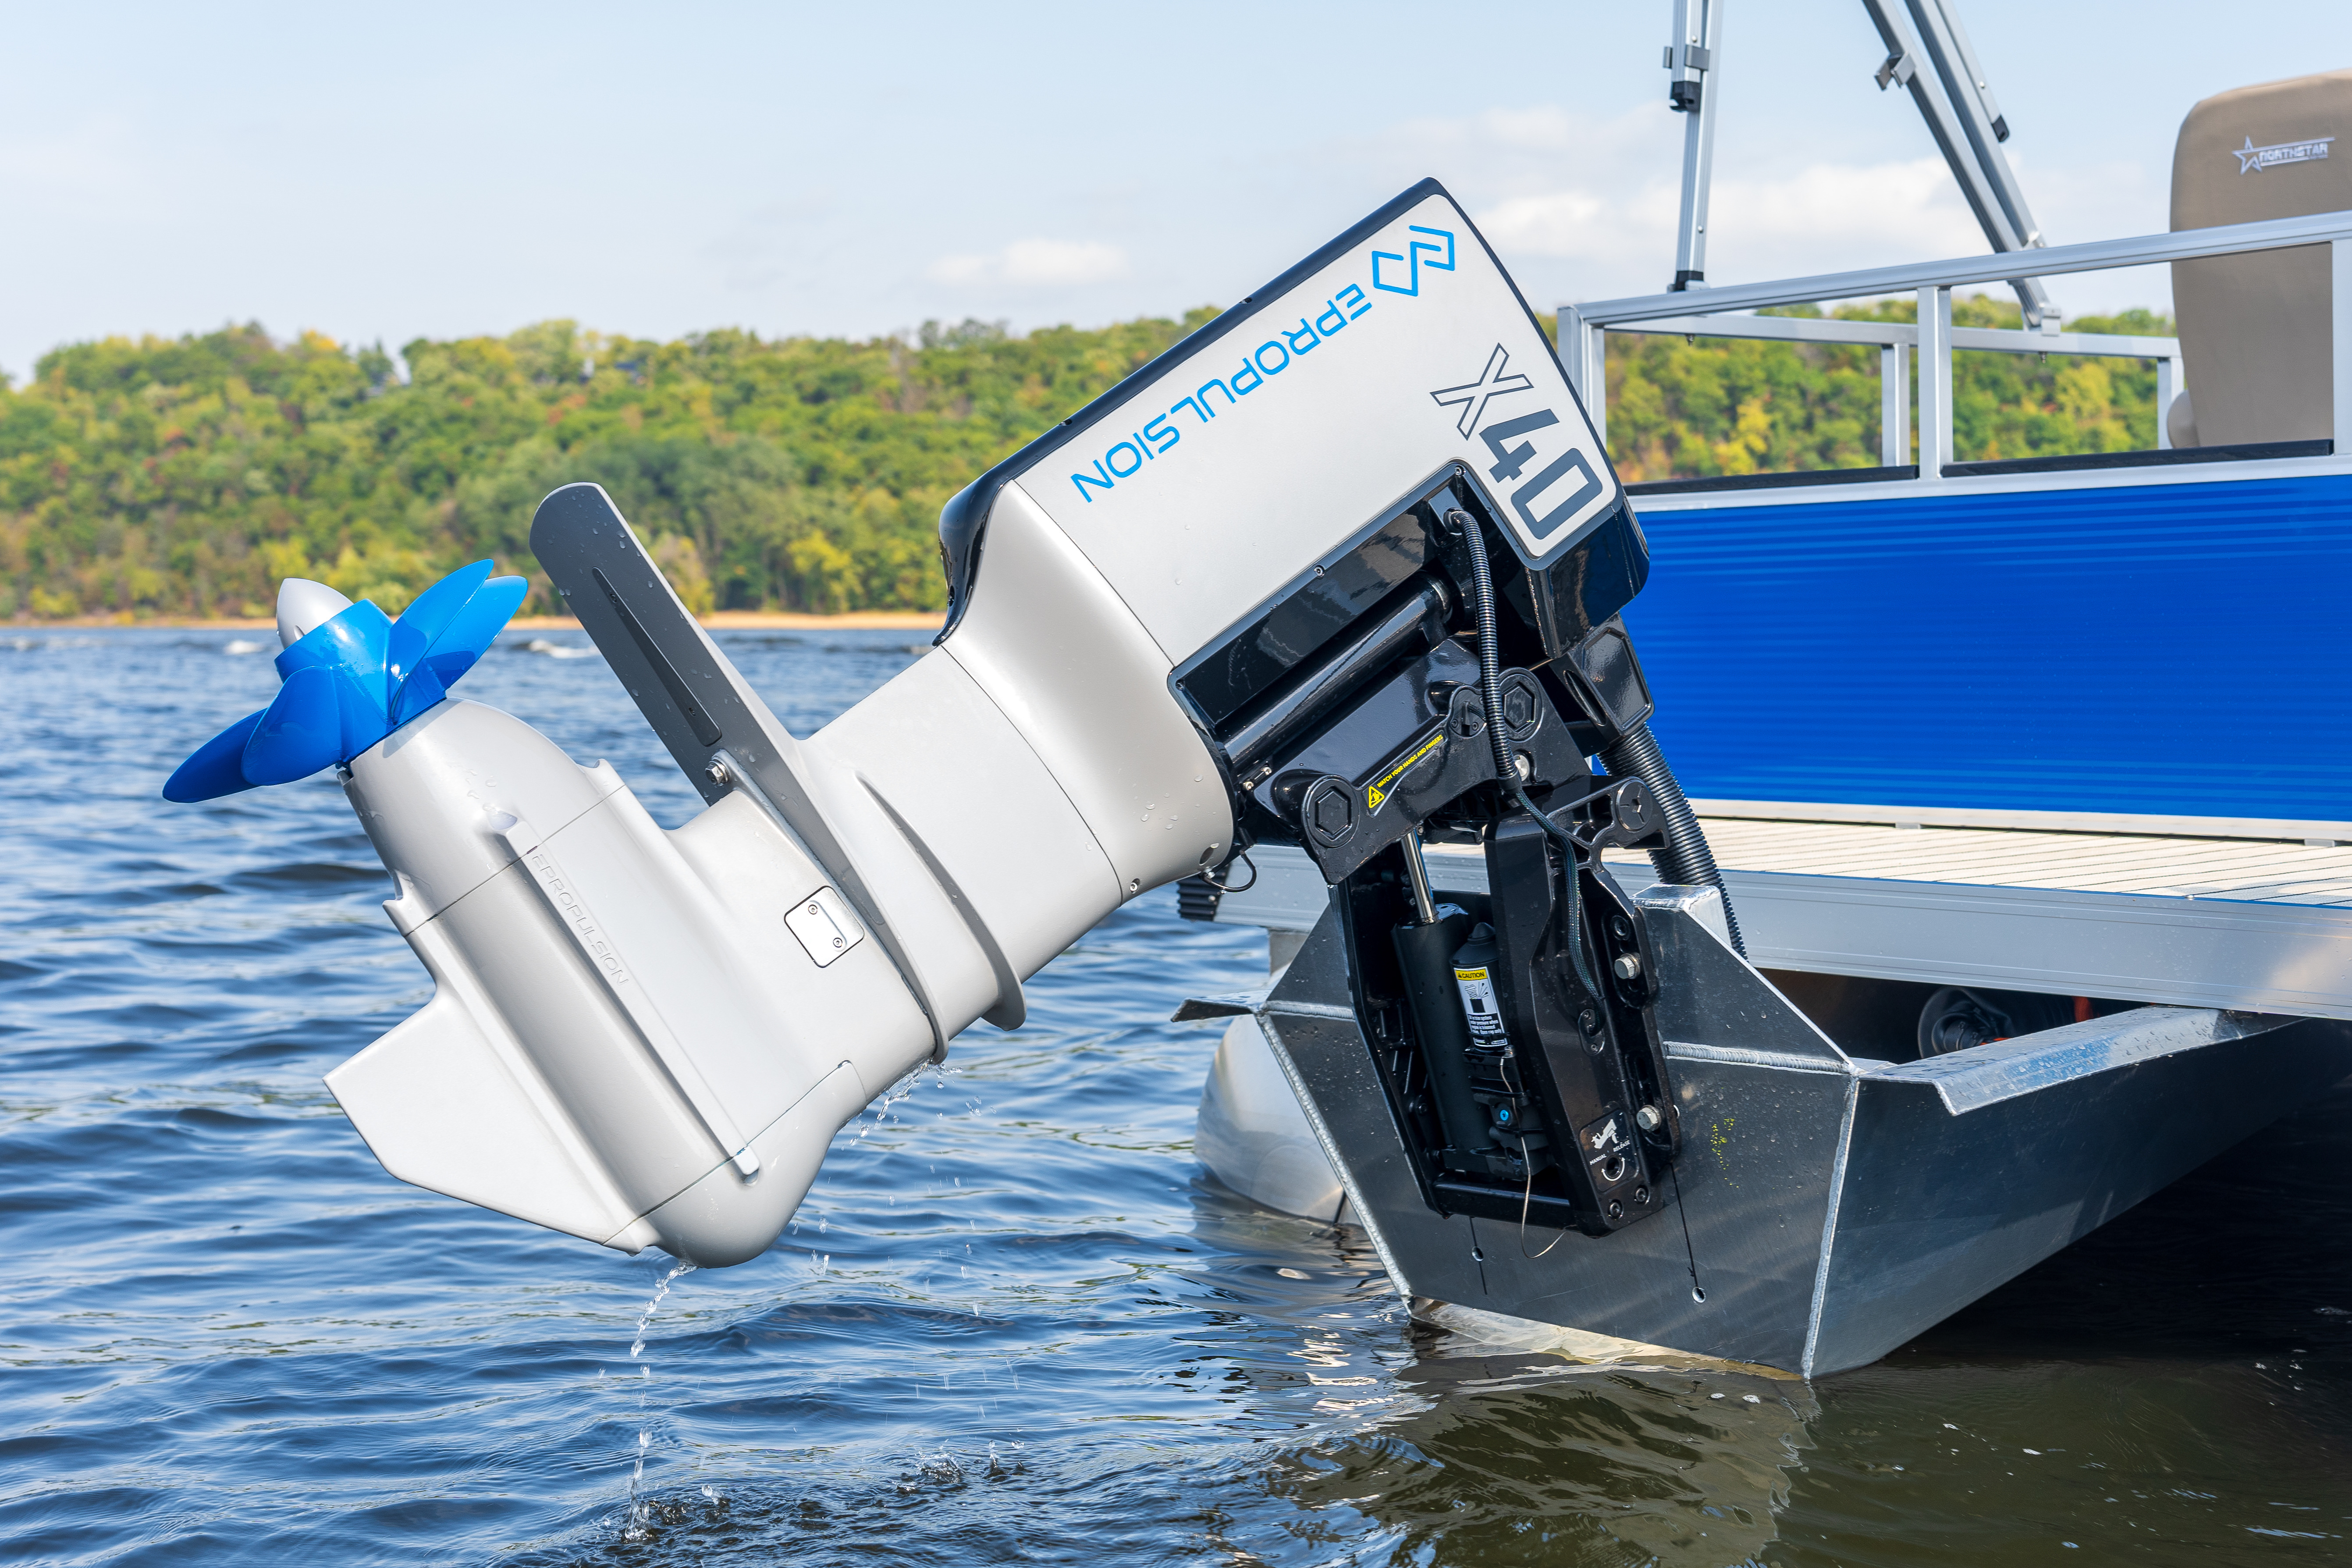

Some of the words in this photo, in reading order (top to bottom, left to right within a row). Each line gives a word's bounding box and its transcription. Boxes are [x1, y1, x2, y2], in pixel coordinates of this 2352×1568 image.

[2258, 142, 2328, 163] NORTHSTAR
[1070, 283, 1372, 503] EPROPULSION
[1429, 342, 1603, 540] X40
[1377, 774, 1393, 788] WATCH
[1391, 765, 1404, 776] YOUR
[1402, 754, 1418, 768] HANDS
[1417, 747, 1427, 757] AND
[1425, 734, 1443, 750] FINGERS
[531, 854, 629, 986] EPROPULSION
[1589, 1153, 1607, 1165] MANUAL
[1613, 1140, 1631, 1152] RELEASE
